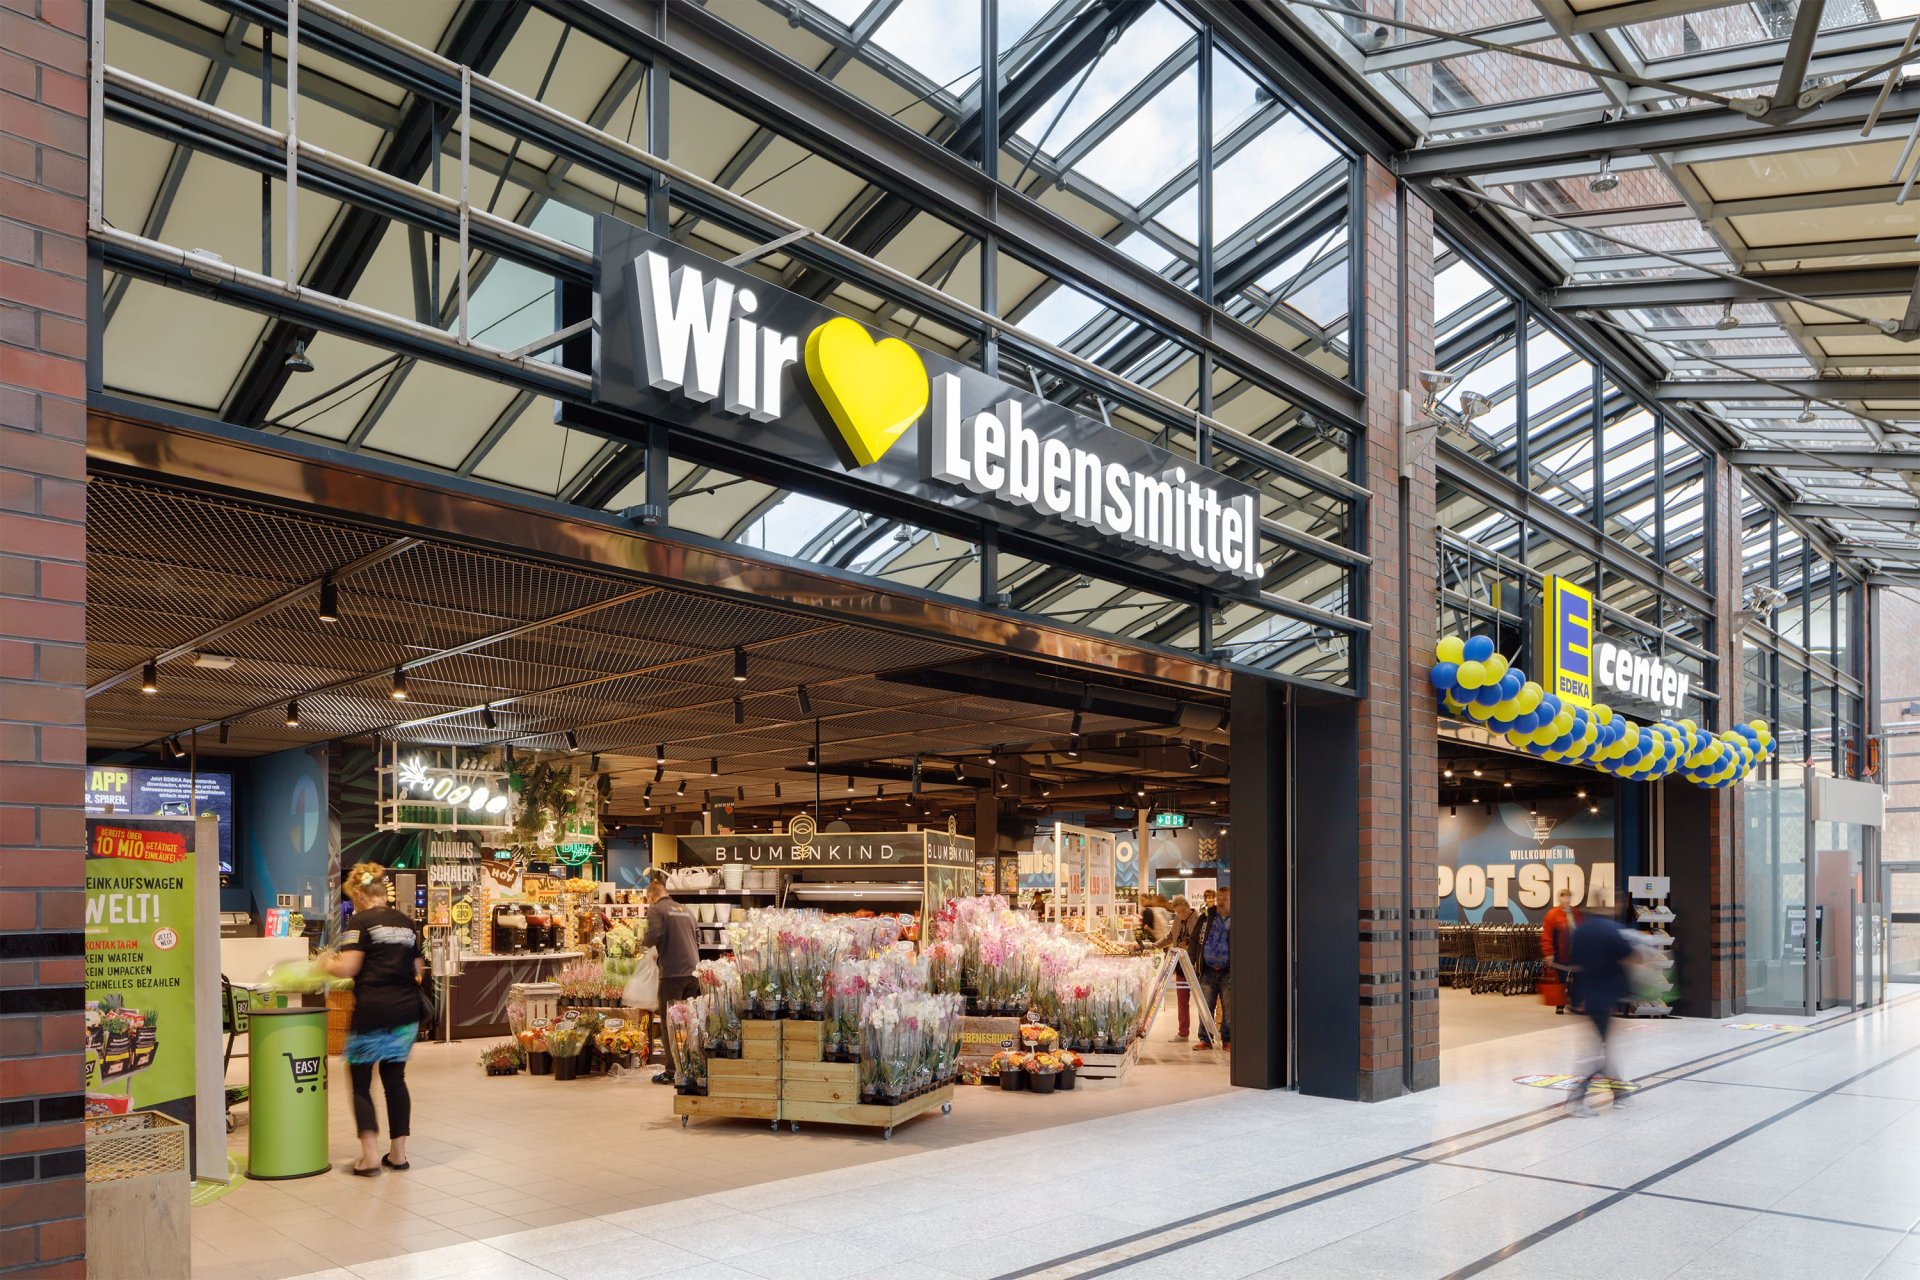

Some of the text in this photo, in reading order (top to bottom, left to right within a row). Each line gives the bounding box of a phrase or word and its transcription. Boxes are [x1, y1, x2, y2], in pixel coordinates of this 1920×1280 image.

[638, 249, 1265, 579] Wir Lebensmittel.
[1560, 588, 1588, 677] E
[1598, 642, 1690, 709] center
[1560, 675, 1590, 699] EDEKA
[91, 771, 128, 792] APP
[94, 794, 128, 806] SPAREN.
[101, 829, 142, 841] BEREITS ÜBER
[96, 836, 113, 855] 10
[117, 838, 144, 859] MIO
[430, 841, 474, 858] ANANAS
[716, 844, 895, 861] BLUMENKIND
[928, 844, 974, 862] BLUMENKIND
[1510, 849, 1575, 861] WILLKOMMEN IN
[430, 864, 474, 882] SCHÄLER
[86, 877, 183, 890] EINKAUFSWAGEN
[85, 893, 160, 924] WELT!
[156, 932, 173, 941] JETZT
[107, 952, 144, 963] WARTEN
[107, 965, 152, 976] UMPACKEN
[85, 977, 180, 990] SCHNELLES BEZAHLEN
[296, 1060, 319, 1074] EASY
